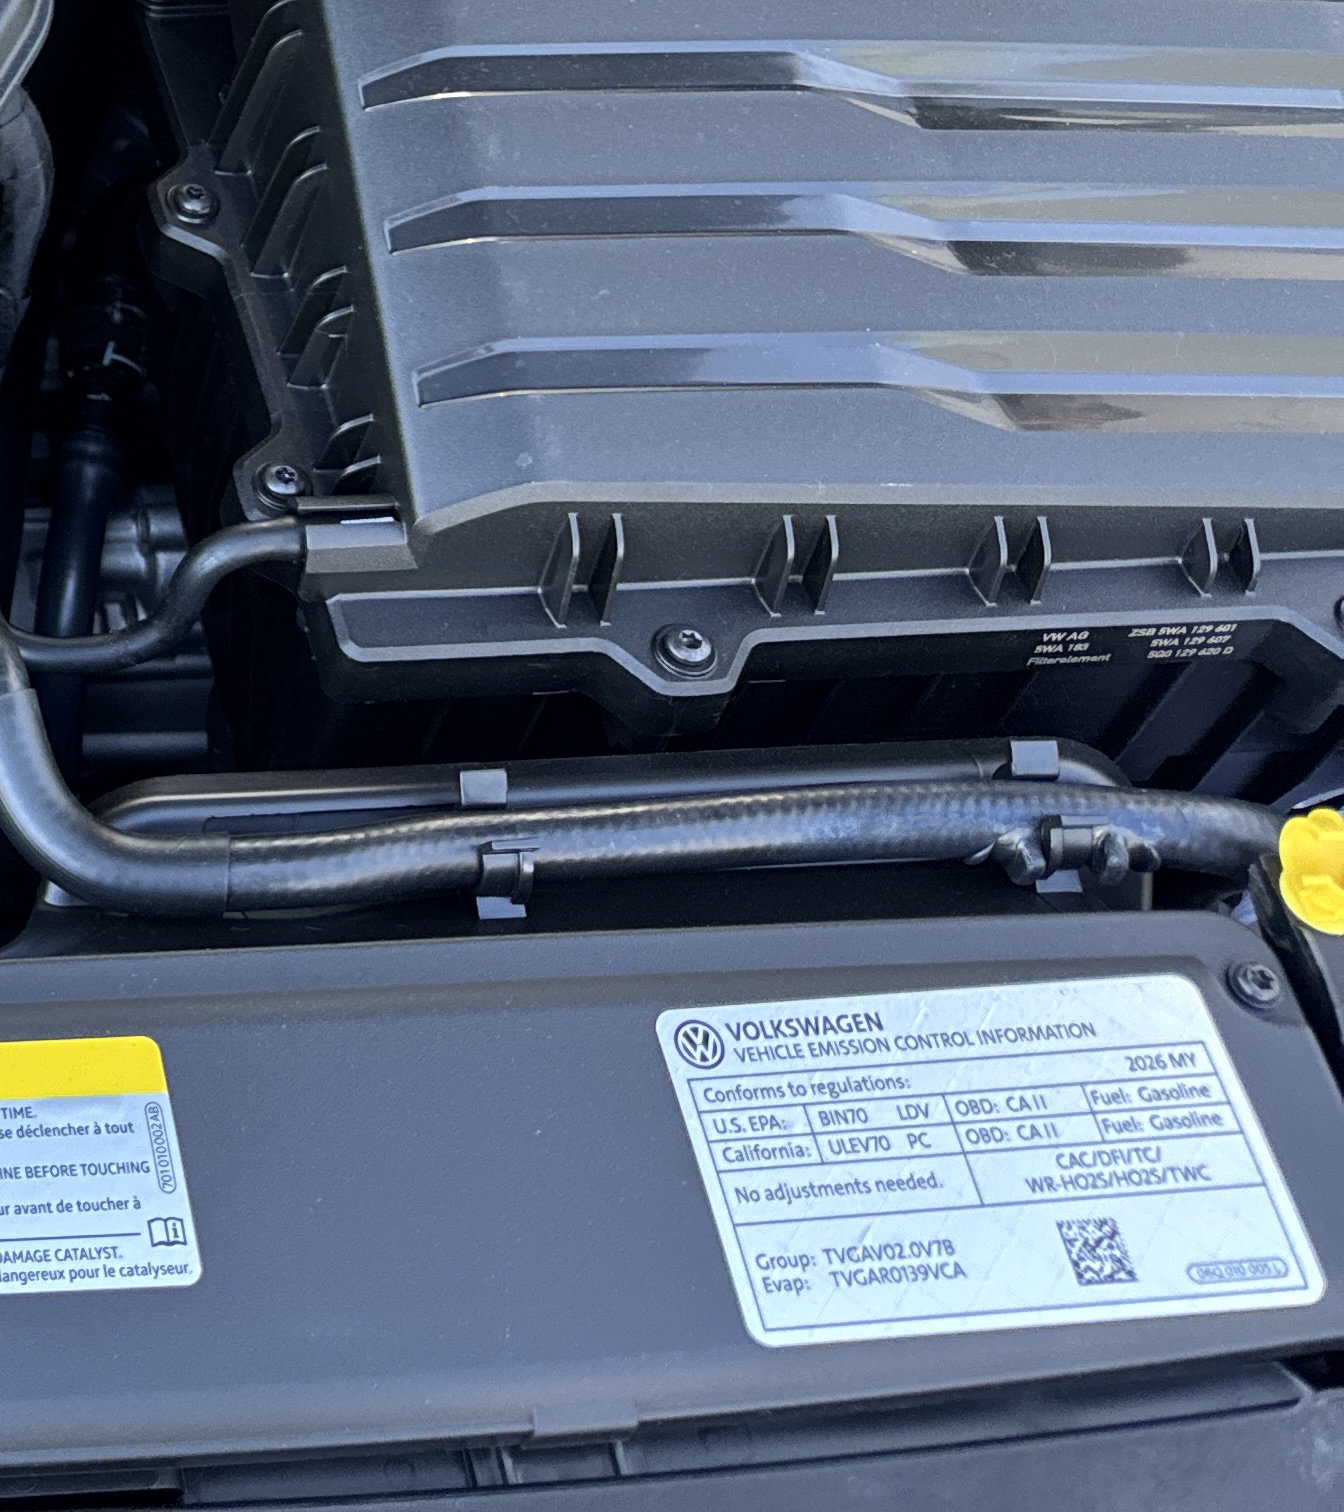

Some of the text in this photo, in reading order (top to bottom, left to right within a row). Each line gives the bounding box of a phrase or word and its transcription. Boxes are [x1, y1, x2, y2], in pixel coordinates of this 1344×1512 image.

[1027, 653, 1111, 665] Filterelement
[725, 1011, 883, 1041] VOLKSWAGEN
[734, 1022, 1096, 1063] VEHICLE EMISSION CONTROL INFORMATION
[1125, 1051, 1195, 1072] 2026 MY
[704, 1074, 910, 1103] Conforms to regulations:
[1091, 1082, 1211, 1108] Fuel: Gasoline
[818, 1107, 868, 1126] BIN70
[897, 1102, 929, 1120] LDV
[955, 1098, 999, 1116] OBD:
[16, 1122, 89, 1138] déclencher
[713, 1114, 787, 1134] U.S. EPA:
[1102, 1110, 1224, 1134] Fuel: Gasoline
[828, 1134, 891, 1155] ULEV70
[907, 1131, 932, 1149] PC
[965, 1126, 1010, 1144] OBD:
[722, 1142, 811, 1163] California:
[25, 1163, 77, 1178] BEFORE
[79, 1160, 150, 1176] TOUCHING
[735, 1171, 943, 1204] No adjustments needed.
[14, 1201, 53, 1215] avant
[76, 1196, 129, 1212] toucher
[55, 1245, 123, 1261] CATALYST.
[756, 1252, 816, 1272] Group:
[69, 1267, 99, 1282] pour
[119, 1261, 192, 1279] catalyseur.
[762, 1275, 810, 1295] Evap:
